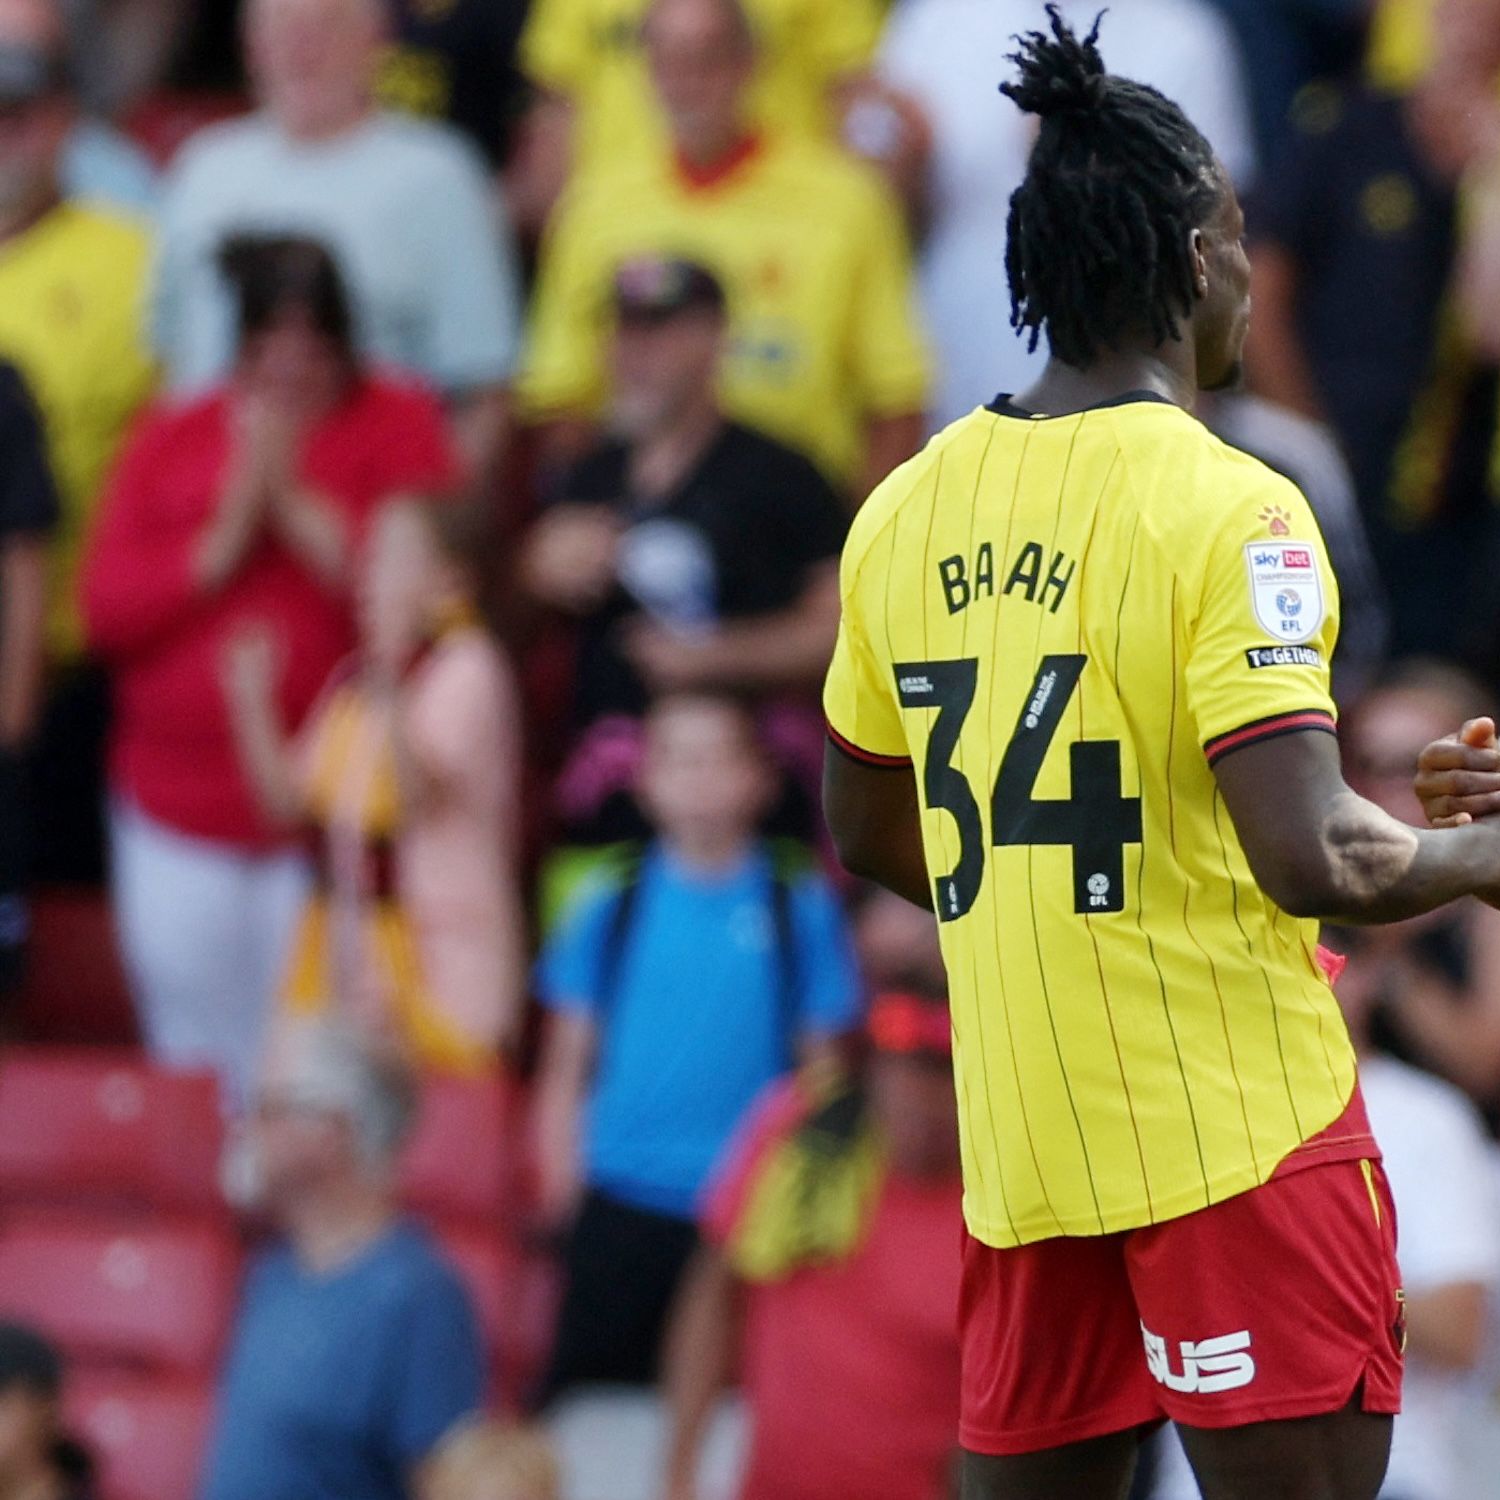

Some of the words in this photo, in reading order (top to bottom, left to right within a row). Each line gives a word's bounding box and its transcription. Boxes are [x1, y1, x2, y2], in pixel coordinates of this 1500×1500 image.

[938, 541, 1075, 615] BAAH
[1254, 551, 1279, 567] sky
[1284, 551, 1309, 566] bet
[1281, 620, 1301, 631] EFL
[892, 654, 1143, 922] 34
[1090, 895, 1108, 906] EFL
[1139, 1317, 1256, 1393] SUS
